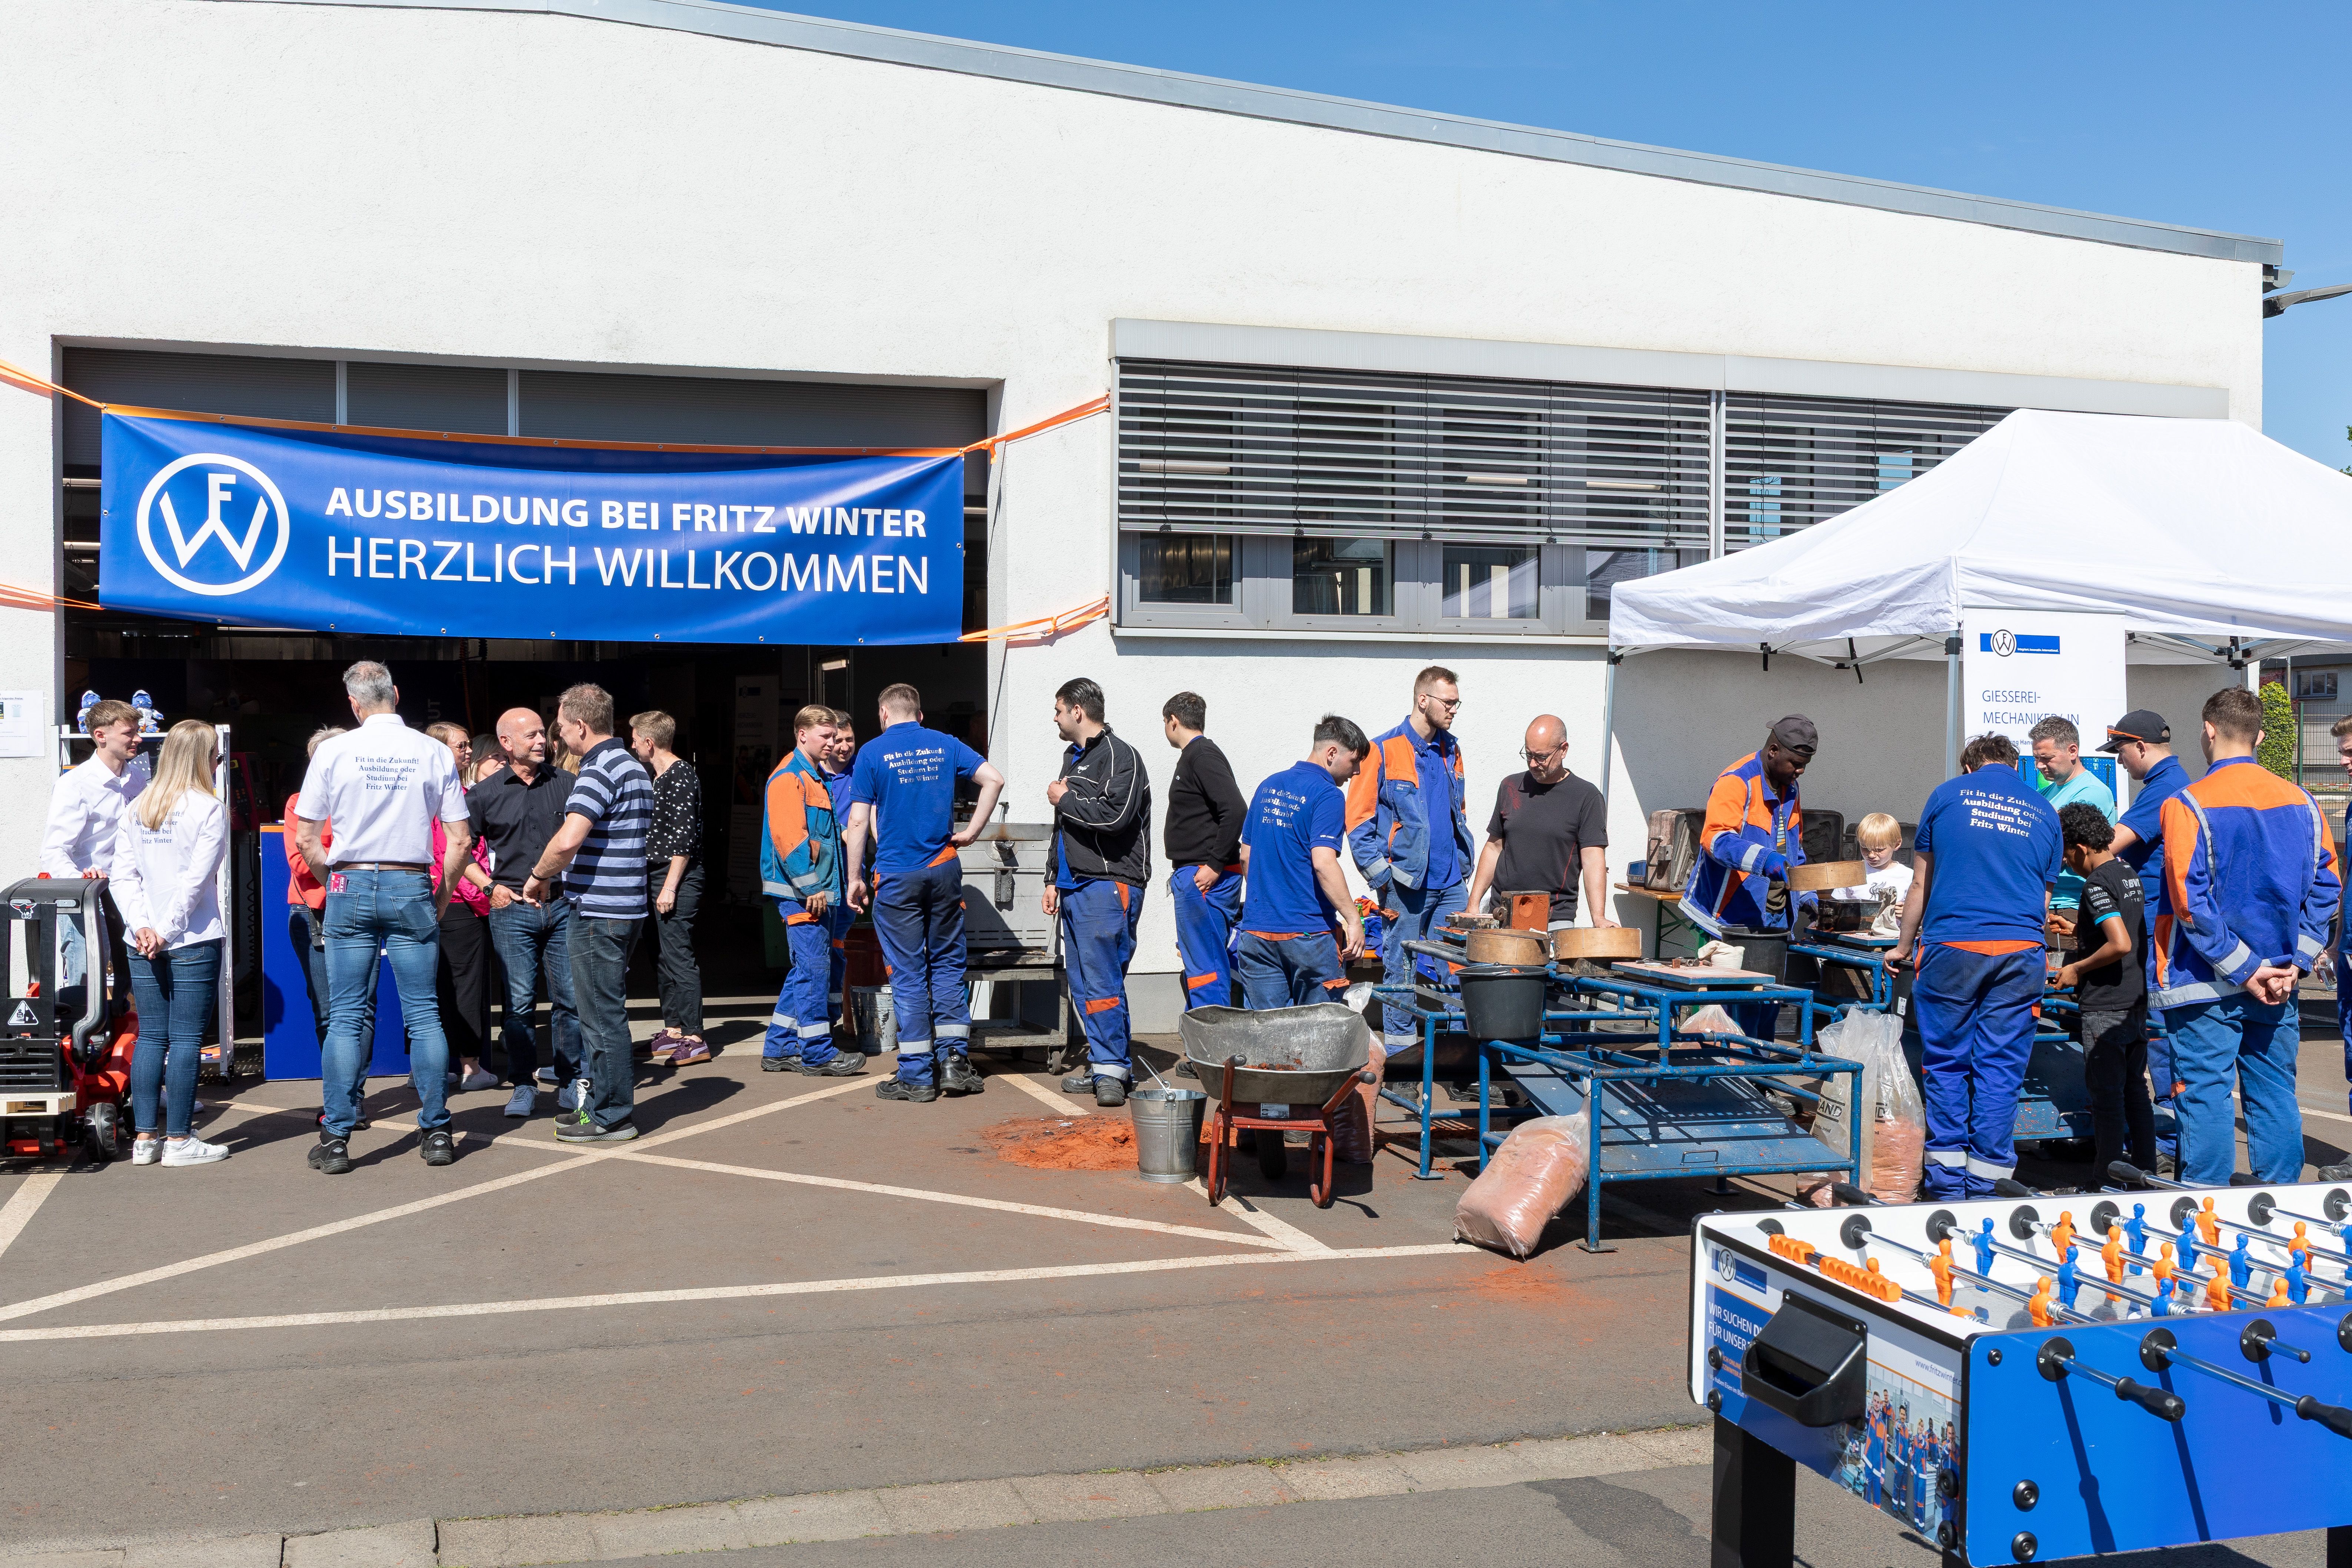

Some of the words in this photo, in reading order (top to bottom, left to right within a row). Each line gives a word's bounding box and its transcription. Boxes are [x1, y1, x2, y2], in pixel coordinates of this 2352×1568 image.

[325, 487, 589, 527] AUSBILDUNG
[602, 500, 659, 530] BEI
[673, 503, 776, 533] FRITZ
[785, 506, 927, 538] WINTER
[328, 536, 576, 585] HERZLICH
[593, 547, 928, 594] WILLKOMMEN
[1983, 690, 2041, 703] GIESSEREI-
[883, 753, 895, 762] Fit
[889, 759, 928, 769] Ausbildung
[359, 765, 398, 773] Ausbildung
[898, 767, 926, 775] Studium
[1962, 798, 2021, 815] Ausbildung
[2023, 811, 2043, 823] oder
[1971, 808, 2015, 823] Studium
[2017, 817, 2032, 828] bei
[1969, 818, 1994, 829] Fritz
[1996, 823, 2030, 838] Winter
[1819, 1100, 1842, 1117] AND
[1709, 1301, 1722, 1319] WIR
[1723, 1309, 1752, 1335] SUCHEN
[1709, 1321, 1722, 1339] FÜR
[1723, 1329, 1746, 1351] UNSER
